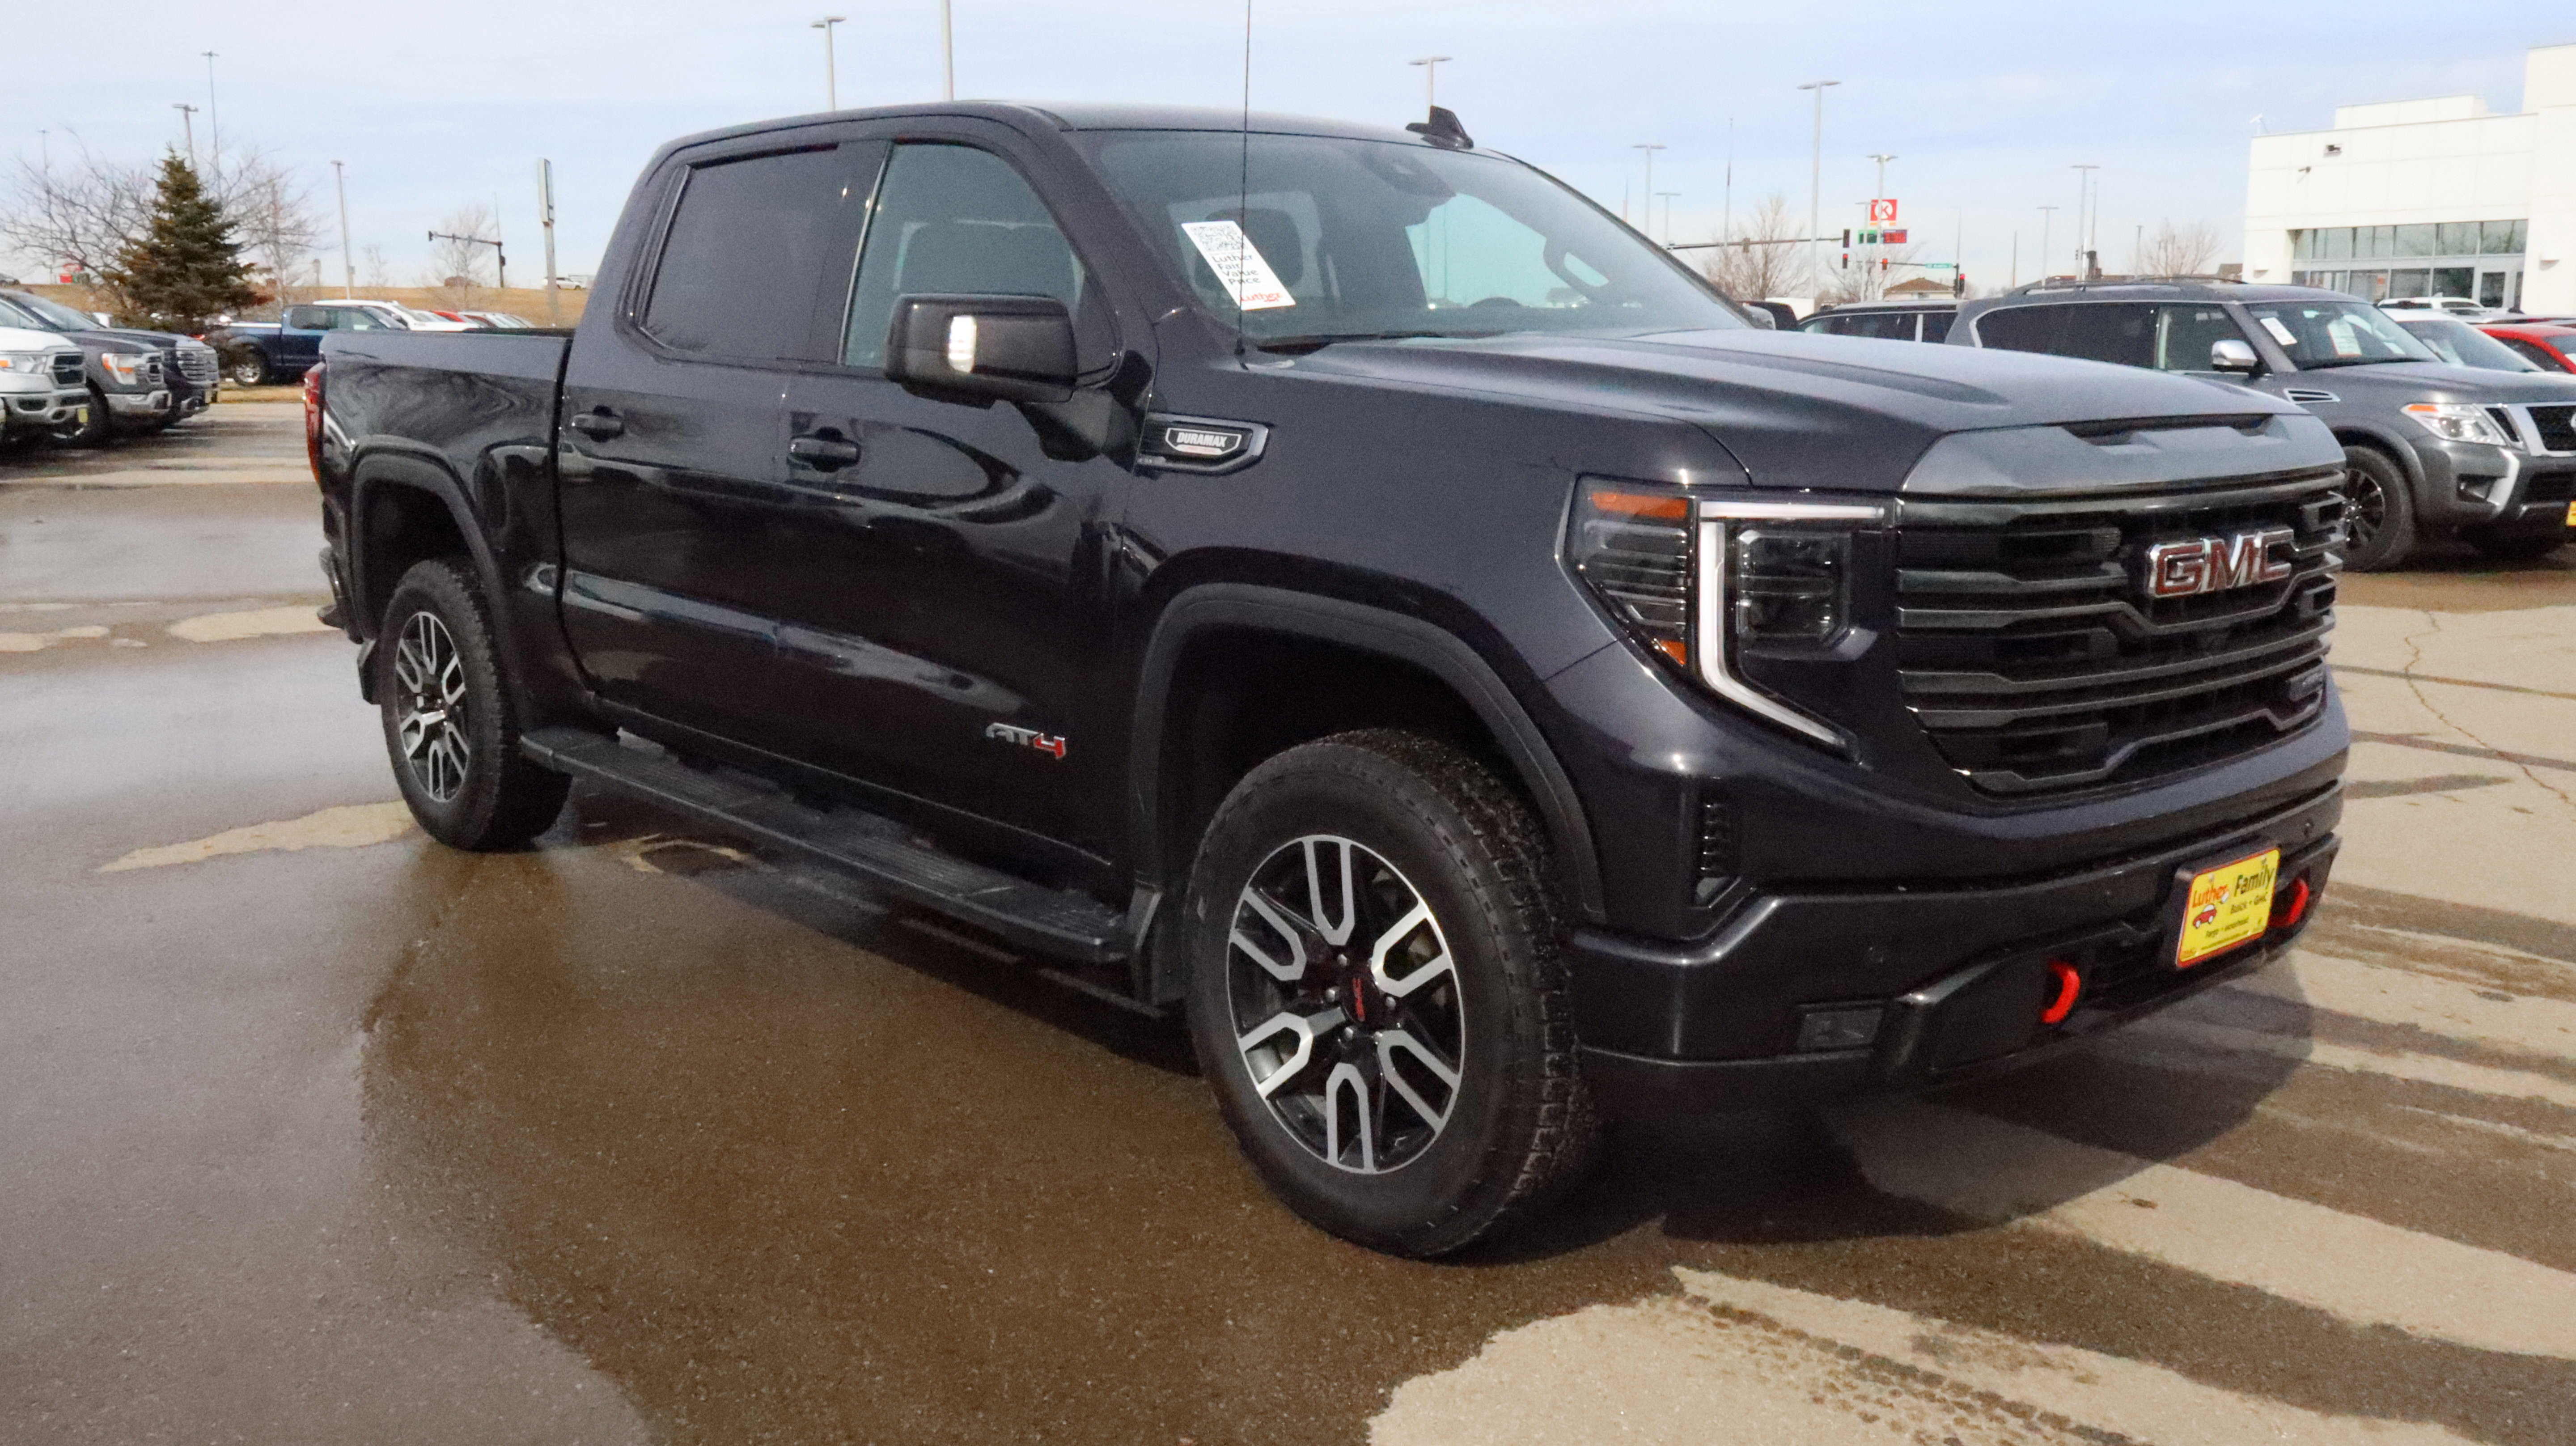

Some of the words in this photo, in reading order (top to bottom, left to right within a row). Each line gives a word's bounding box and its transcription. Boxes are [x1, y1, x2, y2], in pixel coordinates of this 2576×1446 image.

[1212, 254, 1252, 263] Luther
[1239, 293, 1283, 302] Luther
[1177, 432, 1228, 447] DURAMAX
[2148, 529, 2294, 598] GMC
[985, 722, 1066, 759] AT4
[2192, 884, 2228, 908] Luther
[2233, 864, 2275, 897] Family
